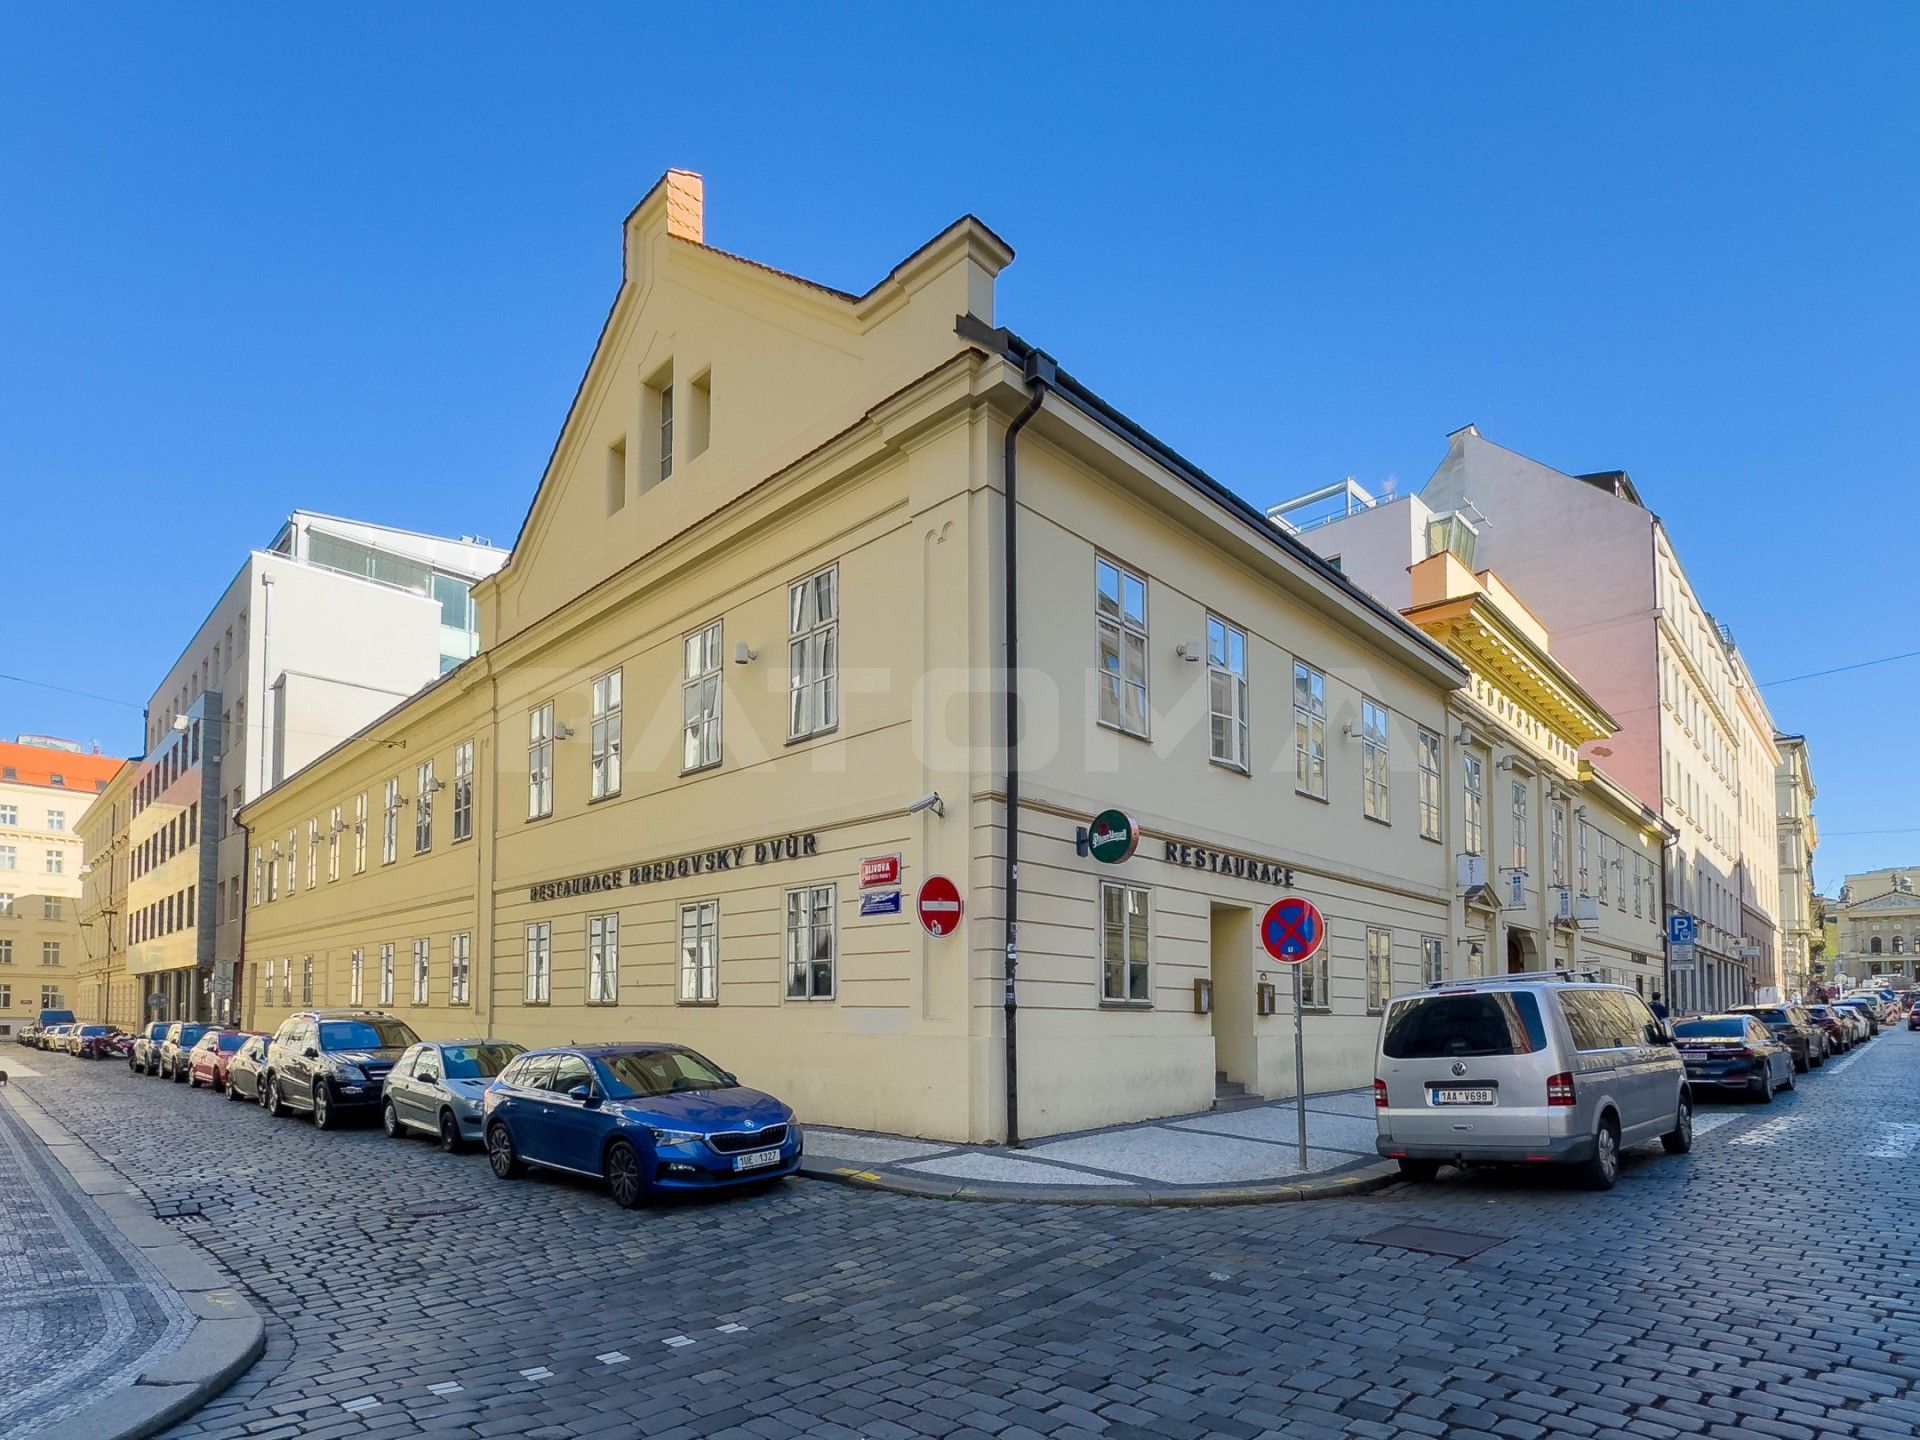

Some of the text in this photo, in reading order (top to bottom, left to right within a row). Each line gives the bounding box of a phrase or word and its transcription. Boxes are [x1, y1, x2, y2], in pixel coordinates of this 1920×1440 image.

[1164, 840, 1294, 888] RESTAURACE
[529, 869, 622, 902] RESTAURACE
[1674, 918, 1688, 935] P
[1441, 1091, 1488, 1101] 1AA V698
[759, 1150, 777, 1163] 1327
